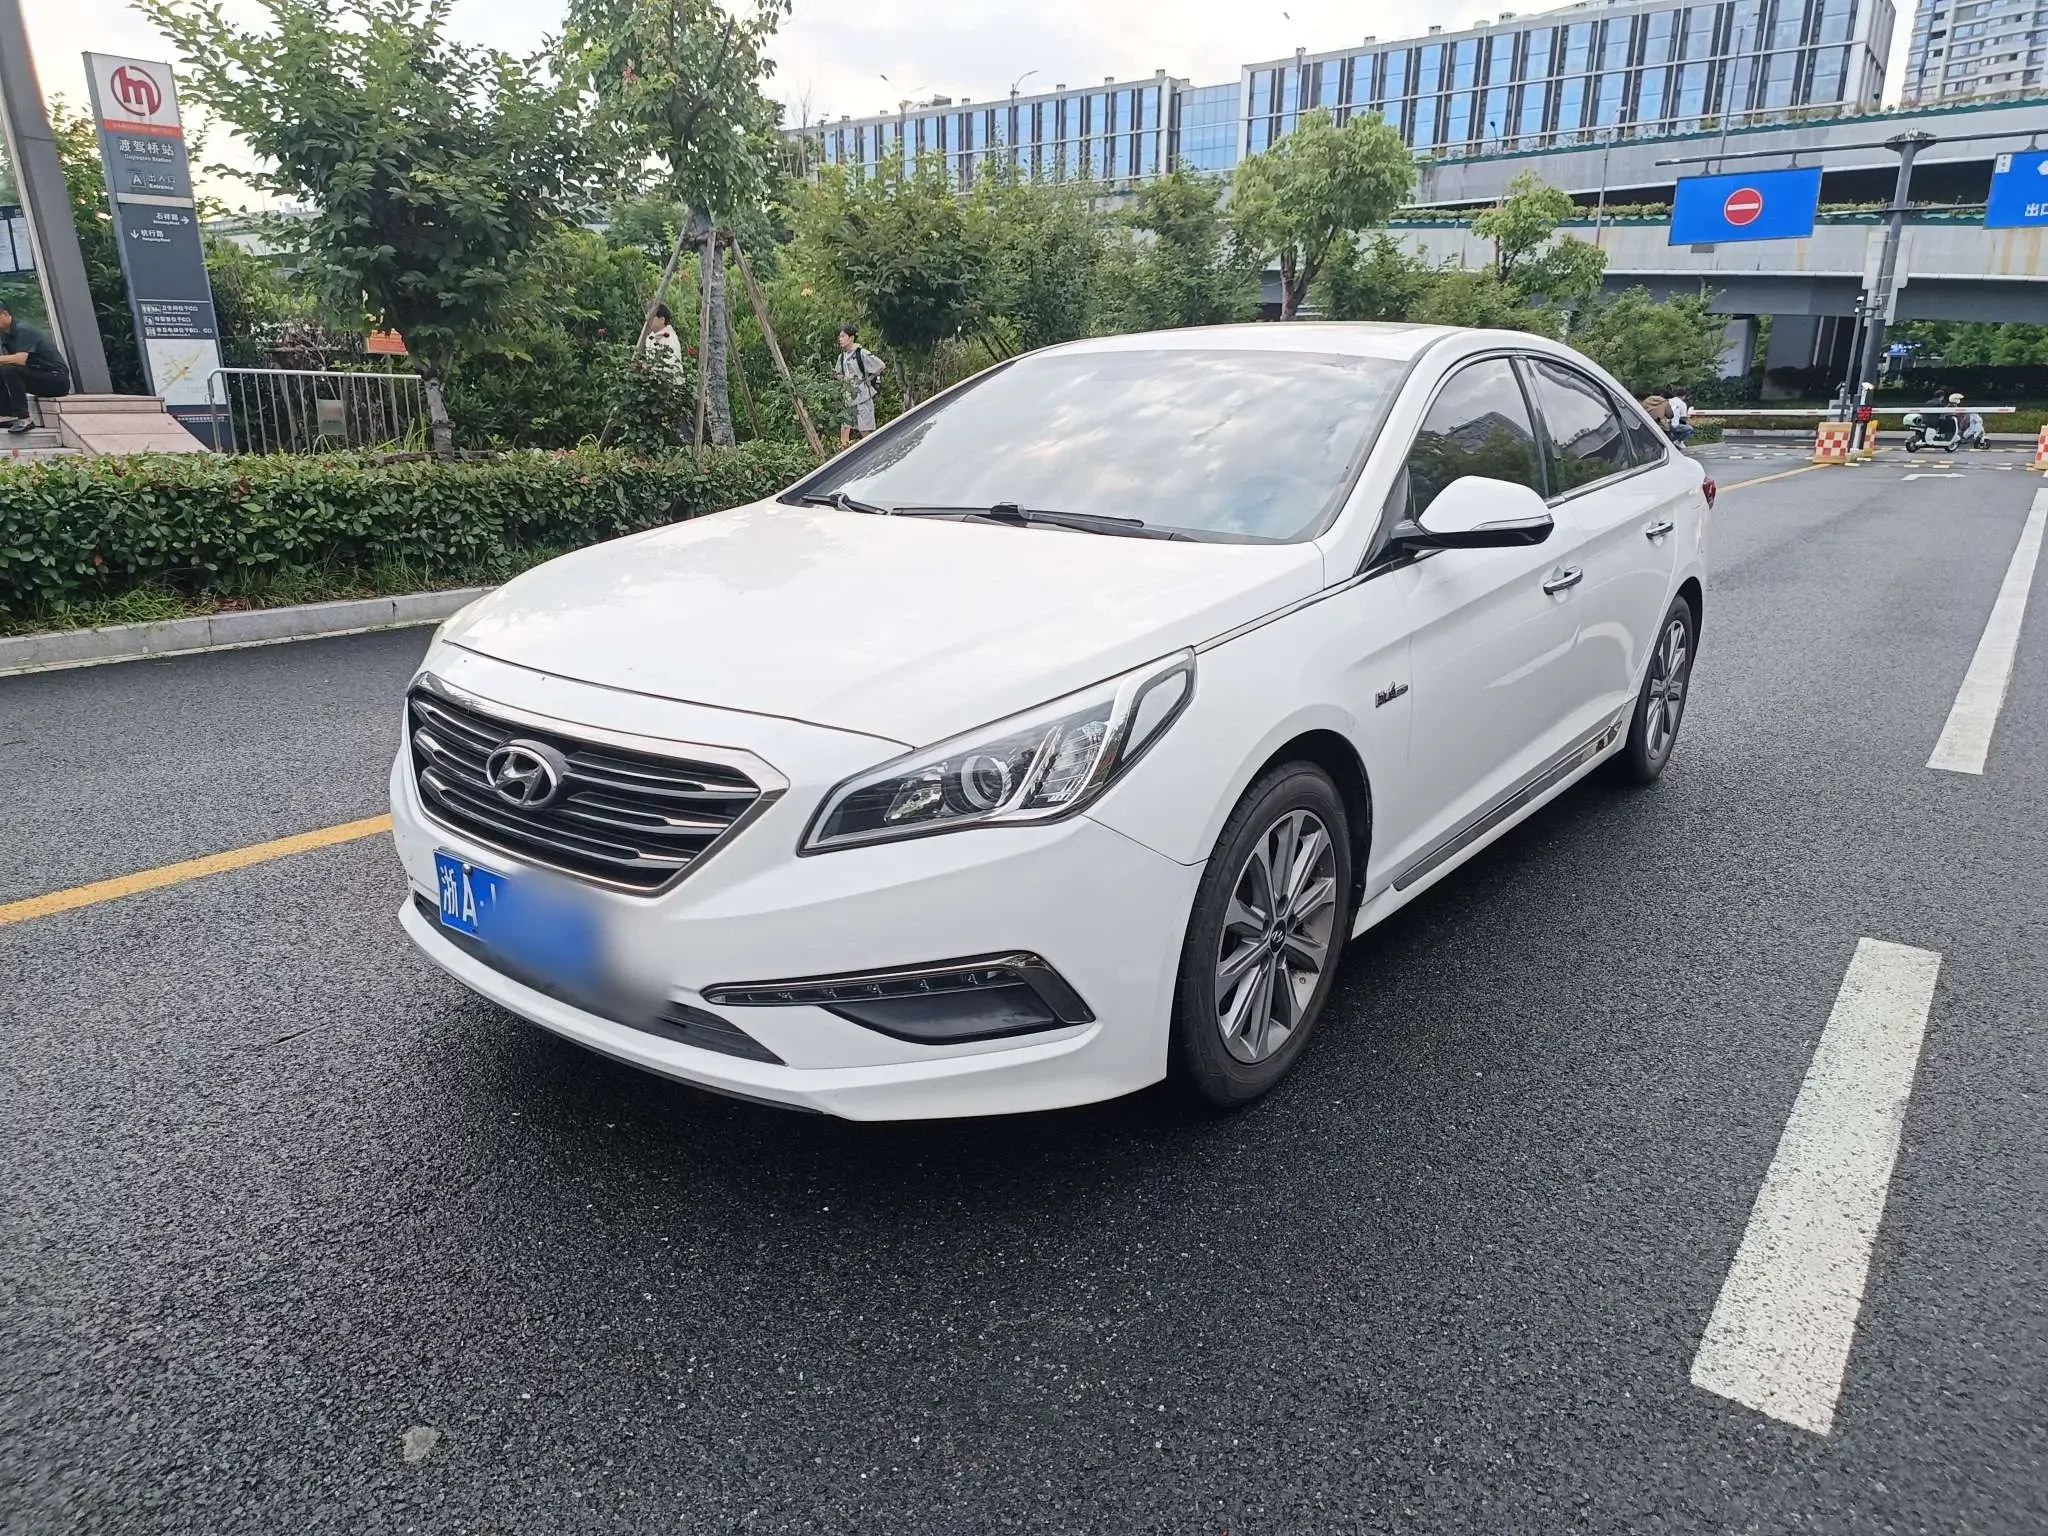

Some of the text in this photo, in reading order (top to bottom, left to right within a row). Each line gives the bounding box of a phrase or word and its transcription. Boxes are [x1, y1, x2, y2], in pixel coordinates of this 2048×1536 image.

[119, 139, 175, 156] 渡驾桥站
[132, 174, 143, 185] A
[148, 174, 176, 184] 出入口
